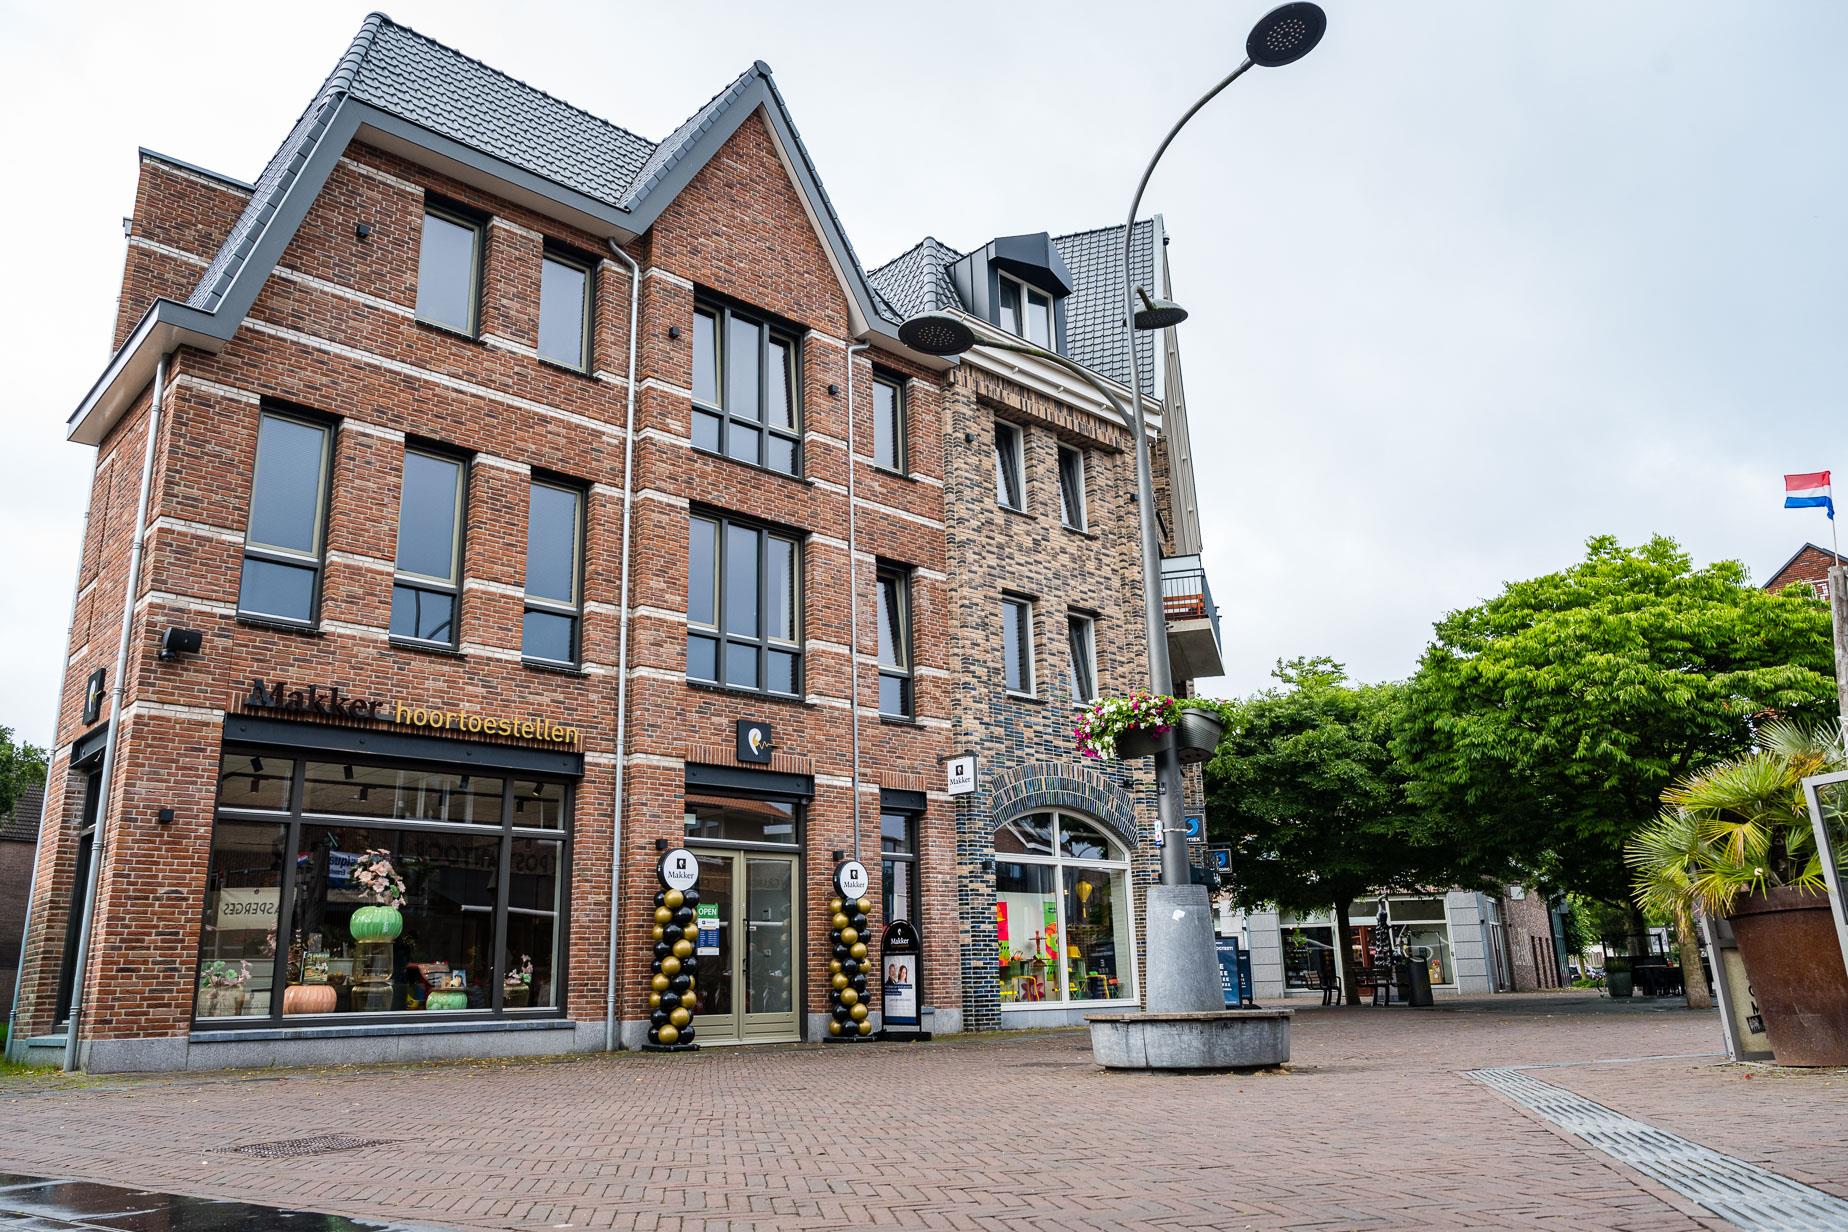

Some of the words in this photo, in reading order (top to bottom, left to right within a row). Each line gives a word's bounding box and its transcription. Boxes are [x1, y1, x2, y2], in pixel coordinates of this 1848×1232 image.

[244, 678, 384, 719] Makker
[395, 700, 578, 743] hoortoestellen
[949, 776, 971, 786] Makker
[667, 871, 695, 880] Makker
[698, 907, 717, 916] OPEN
[890, 937, 909, 945] Makker
